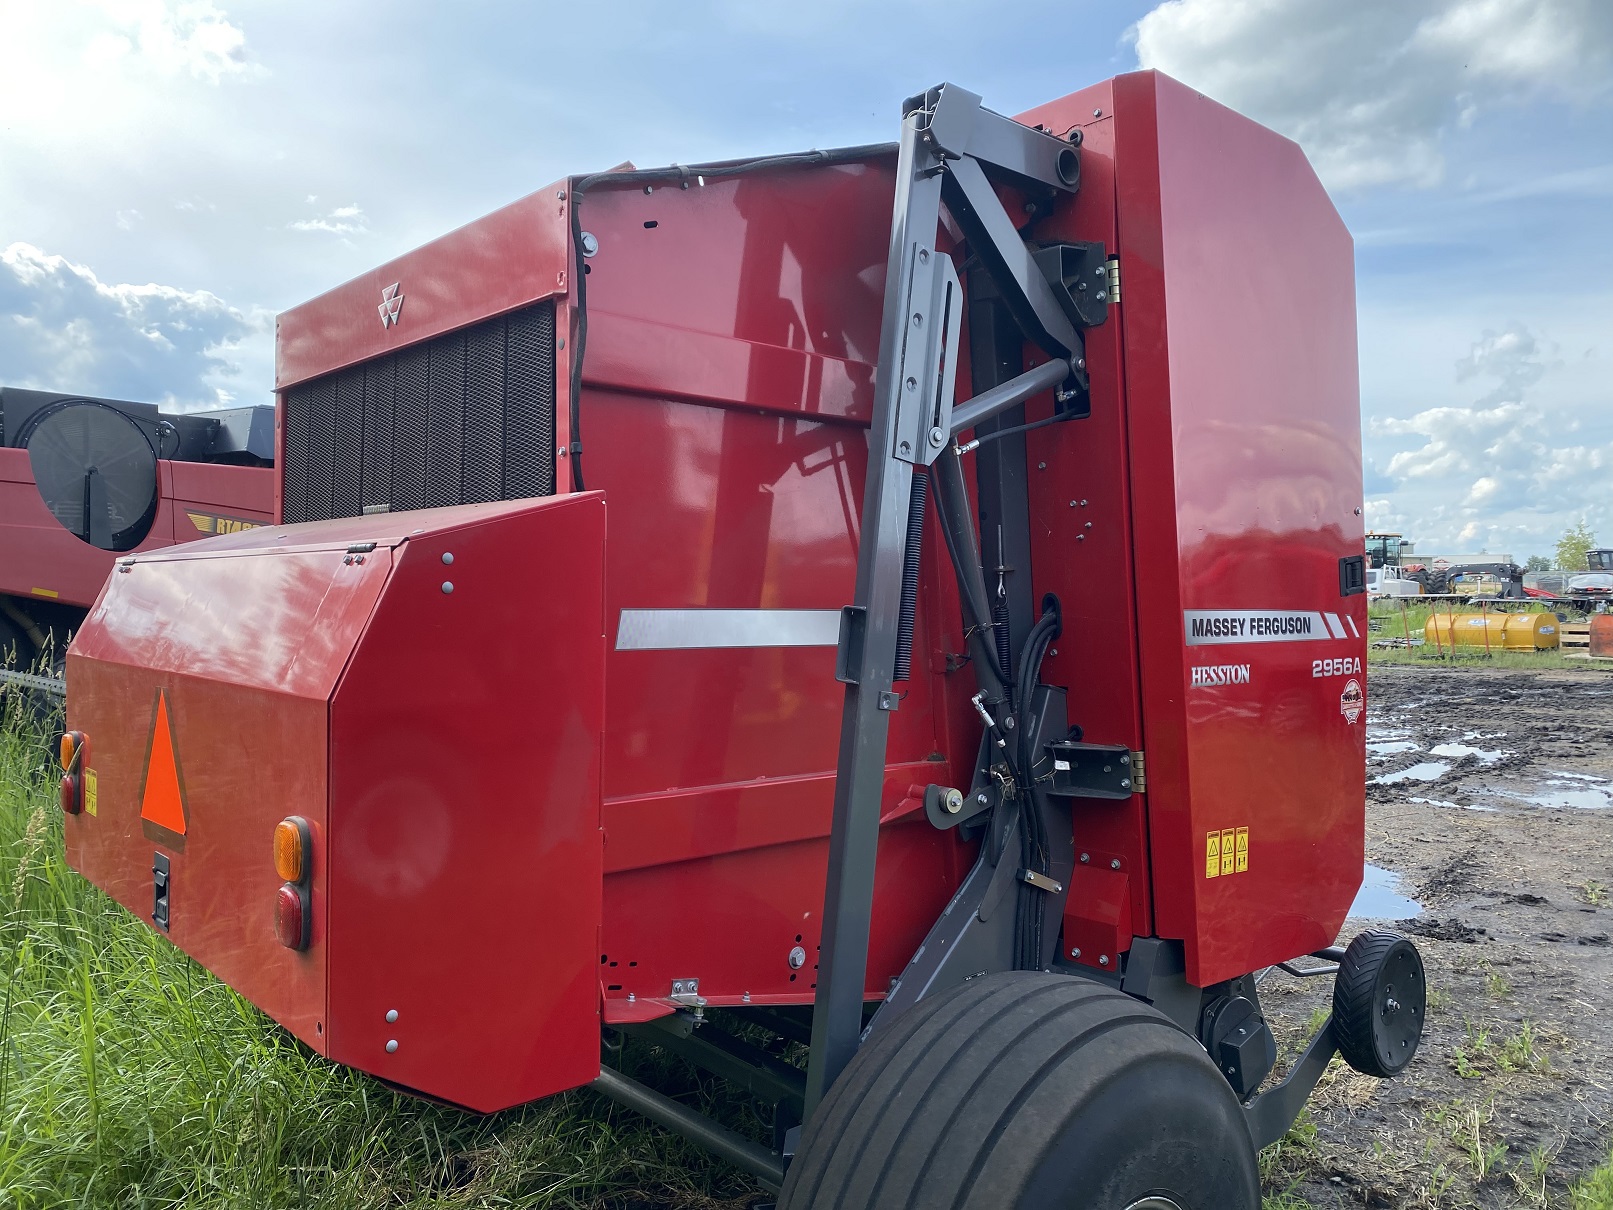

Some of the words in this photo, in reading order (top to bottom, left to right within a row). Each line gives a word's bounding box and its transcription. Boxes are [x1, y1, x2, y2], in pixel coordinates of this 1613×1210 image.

[1191, 617, 1246, 637] MASSEY
[1249, 616, 1311, 635] FERGUSON
[1190, 664, 1251, 687] HESSTON
[1312, 657, 1362, 678] 2956A
